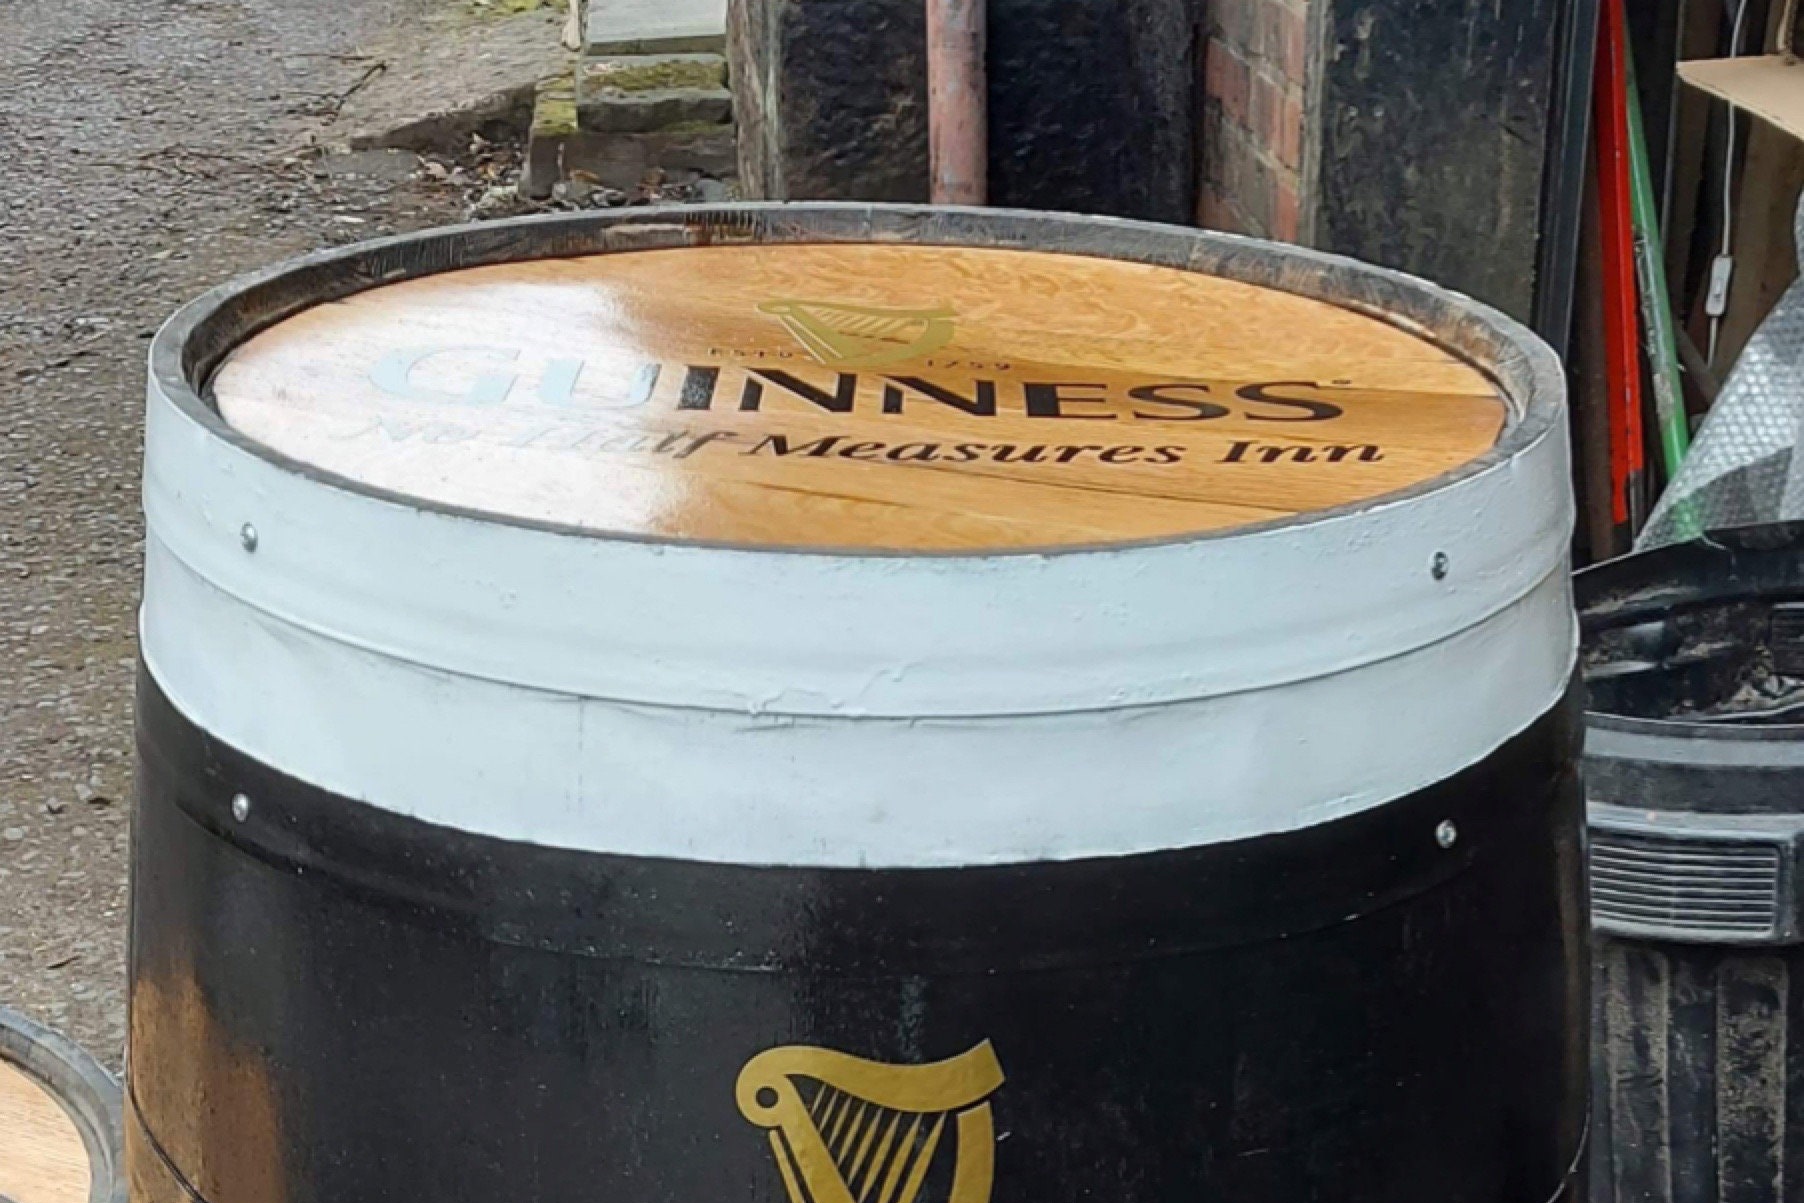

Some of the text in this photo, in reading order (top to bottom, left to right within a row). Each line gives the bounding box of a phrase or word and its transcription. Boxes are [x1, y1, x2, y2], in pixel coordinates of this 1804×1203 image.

[368, 343, 1344, 422] GUINNESS
[738, 434, 1188, 464] Measures
[1214, 439, 1385, 464] Inn
